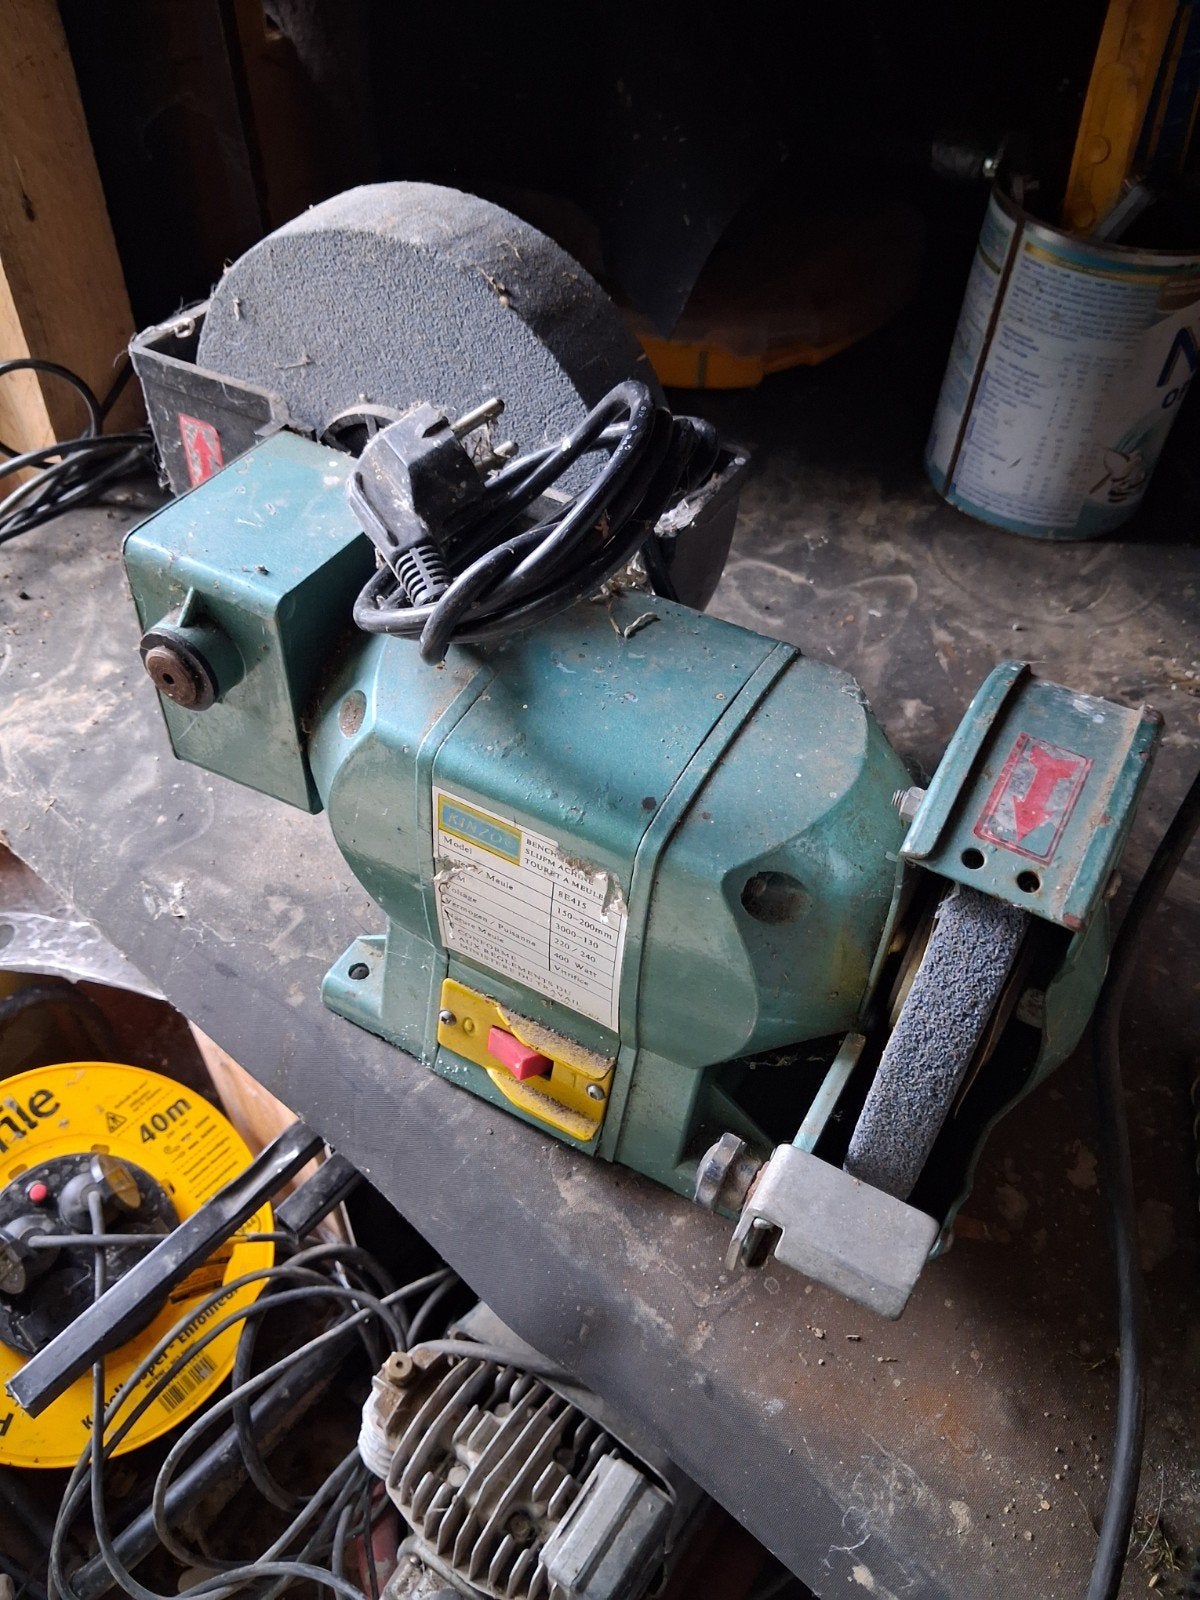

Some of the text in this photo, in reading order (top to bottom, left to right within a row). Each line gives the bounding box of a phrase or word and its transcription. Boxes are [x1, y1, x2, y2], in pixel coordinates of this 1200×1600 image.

[443, 835, 473, 855] Model
[486, 871, 514, 890] Meule
[524, 857, 560, 879] TOURET
[571, 880, 604, 900] MEULE
[553, 952, 569, 963] 400
[554, 937, 570, 950] 220
[580, 950, 596, 963] 240
[139, 1097, 192, 1144] 40m
